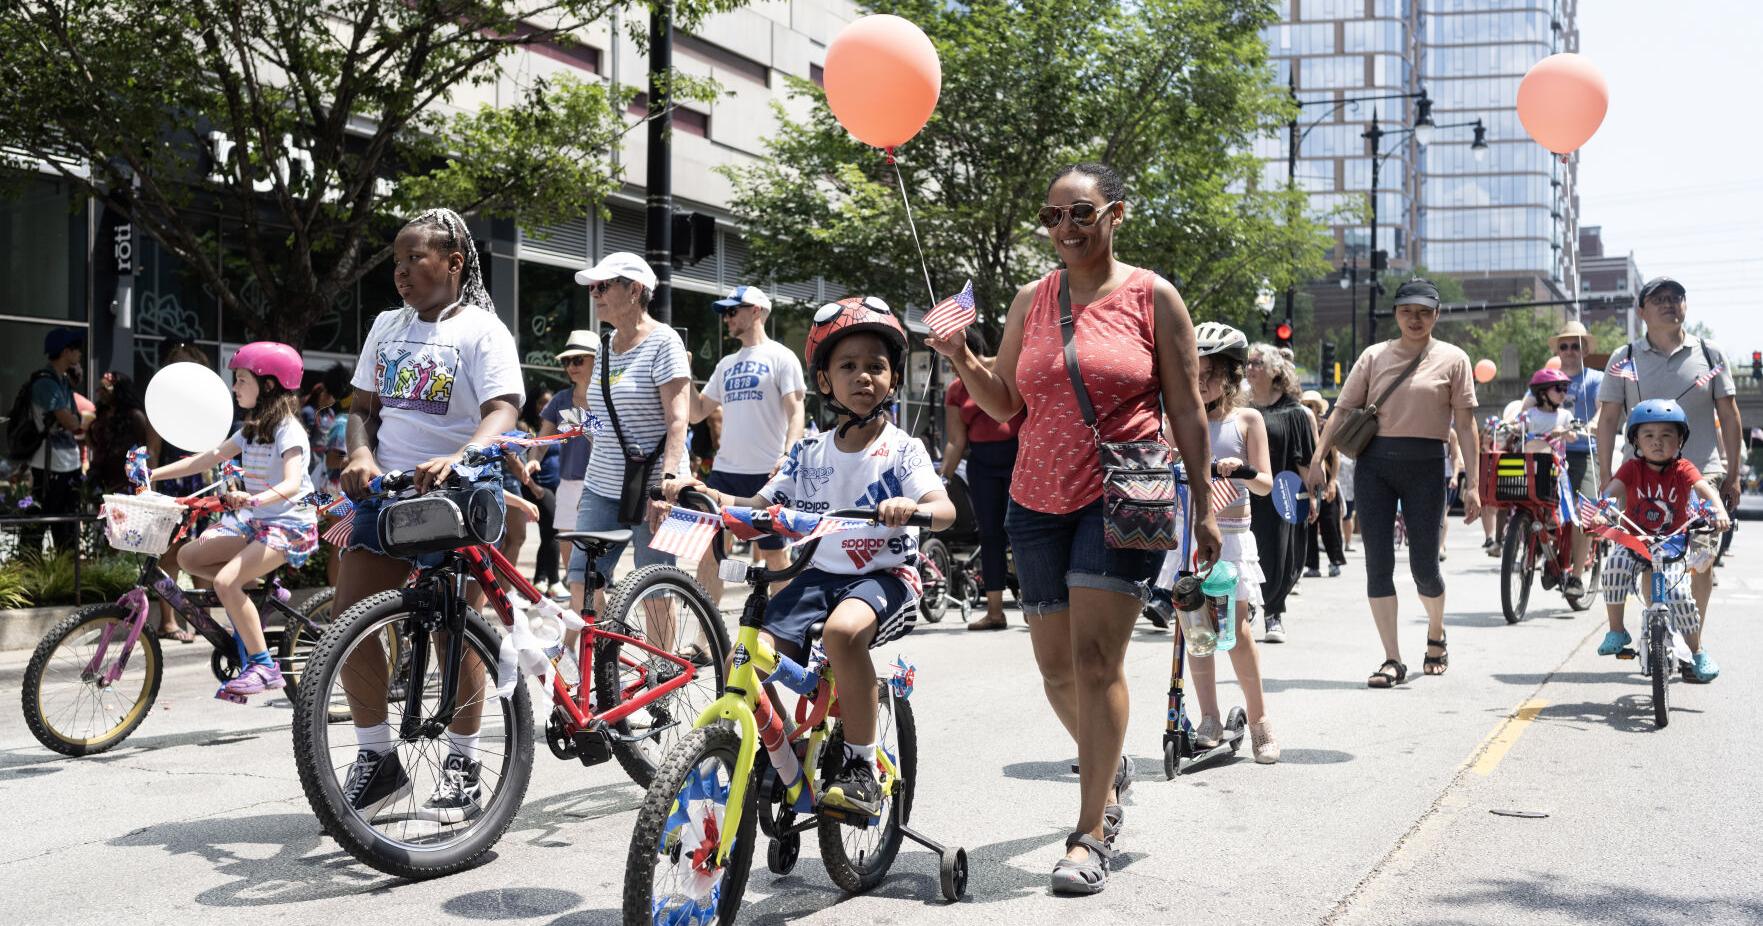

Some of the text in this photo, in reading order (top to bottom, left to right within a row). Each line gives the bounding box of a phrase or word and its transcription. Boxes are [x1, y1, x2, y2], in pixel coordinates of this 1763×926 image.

[114, 223, 131, 271] rōti
[724, 361, 770, 382] PREP
[841, 537, 886, 549] adidas
